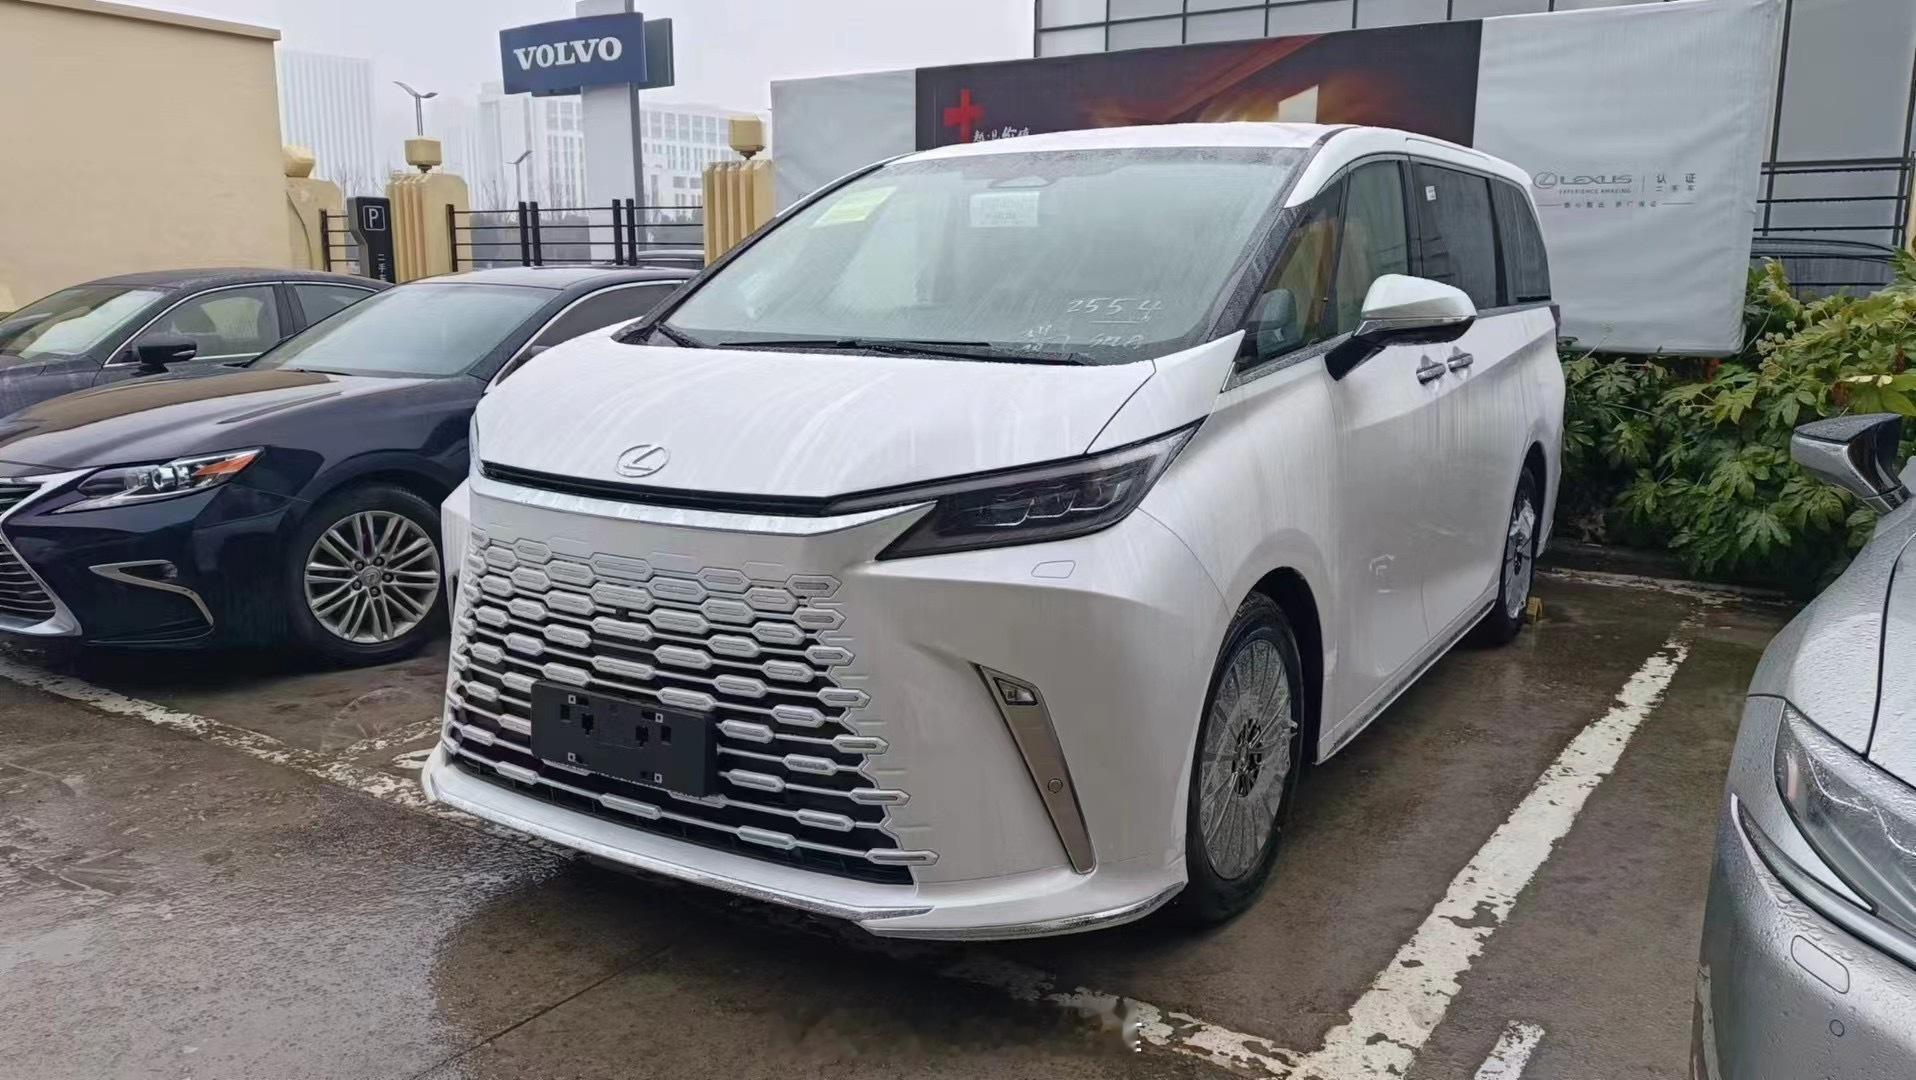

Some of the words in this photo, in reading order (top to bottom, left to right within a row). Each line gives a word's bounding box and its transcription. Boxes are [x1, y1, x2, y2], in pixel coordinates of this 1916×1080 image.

[513, 37, 623, 70] VOLVO
[1560, 174, 1633, 185] LEXUS
[1656, 172, 1697, 184] 认证
[368, 208, 379, 229] P
